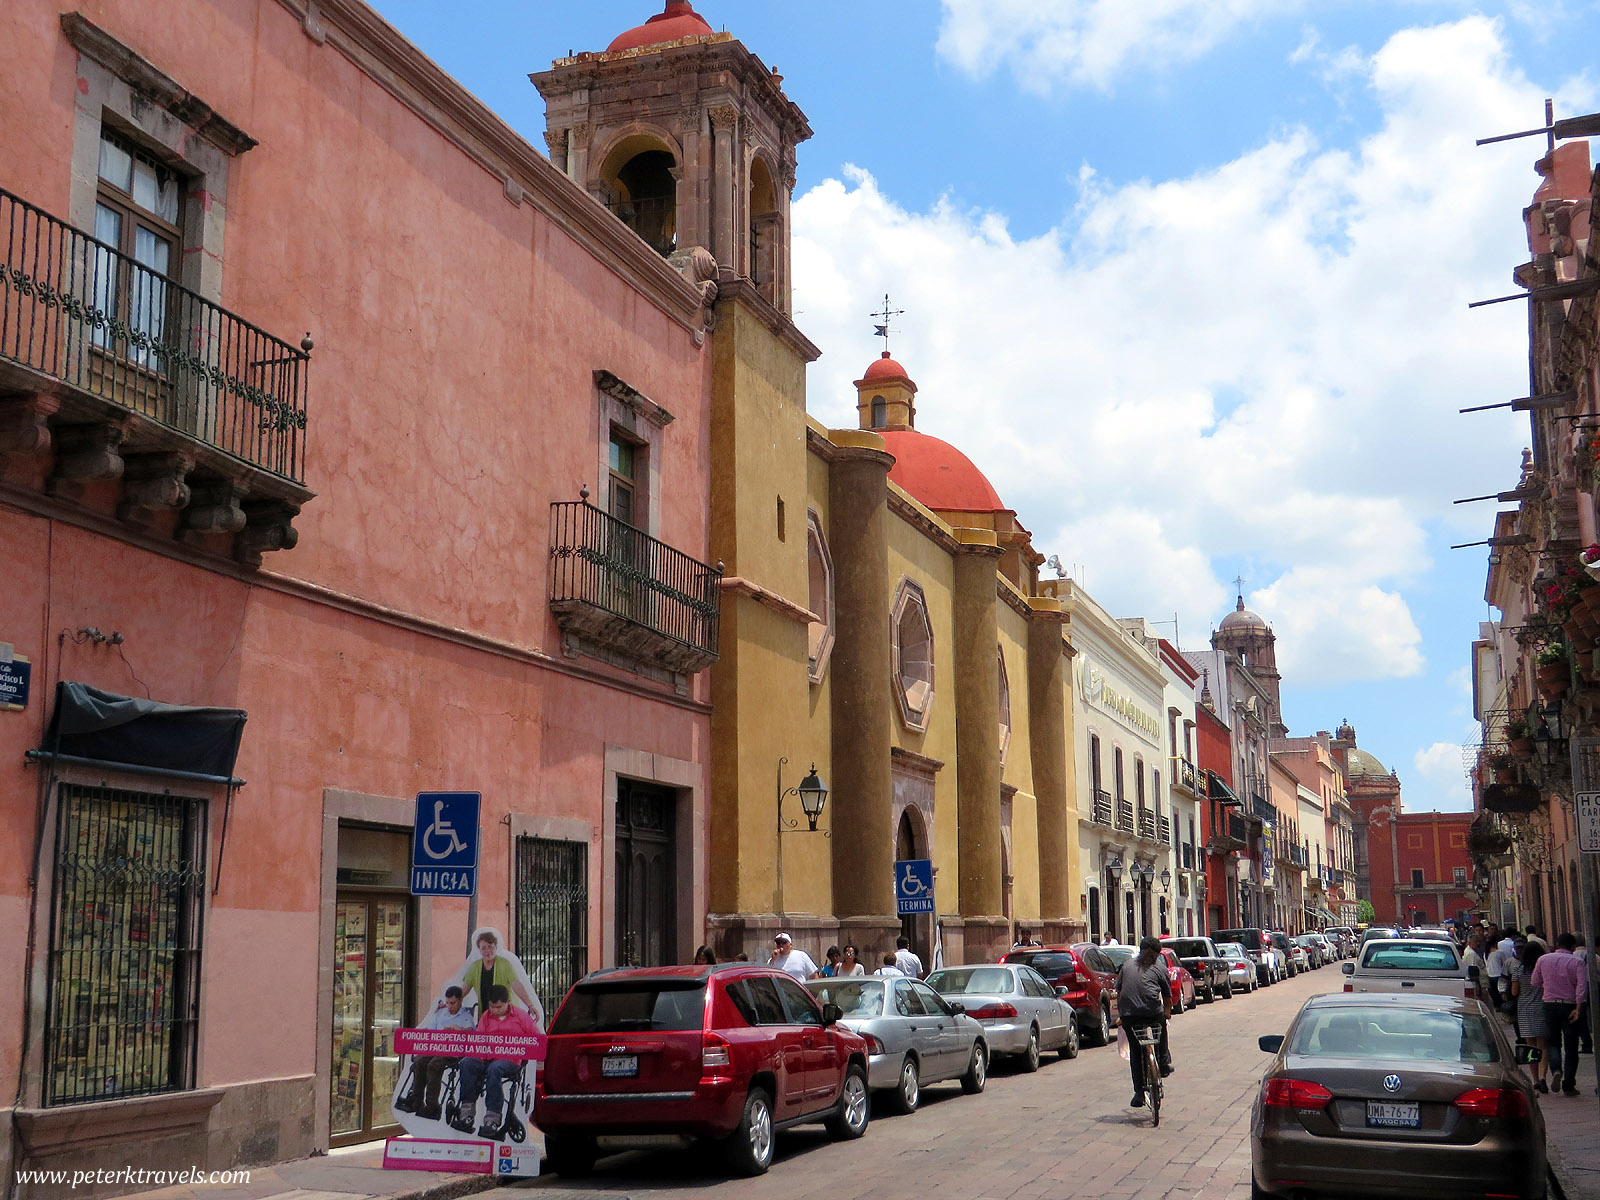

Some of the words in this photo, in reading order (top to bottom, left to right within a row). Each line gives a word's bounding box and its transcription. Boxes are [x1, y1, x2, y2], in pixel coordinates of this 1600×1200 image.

[900, 900, 932, 911] TERMINA
[402, 1031, 430, 1041] PORQUE
[431, 1033, 467, 1043] RESPETAS
[467, 1034, 504, 1045] NUESTROS
[505, 1036, 540, 1047] LUGARES,
[413, 1042, 429, 1051] NOS
[429, 1043, 464, 1053] FACILITAS
[465, 1045, 475, 1053] LA
[475, 1045, 494, 1054] VIDA.
[494, 1046, 526, 1056] GRACIAS
